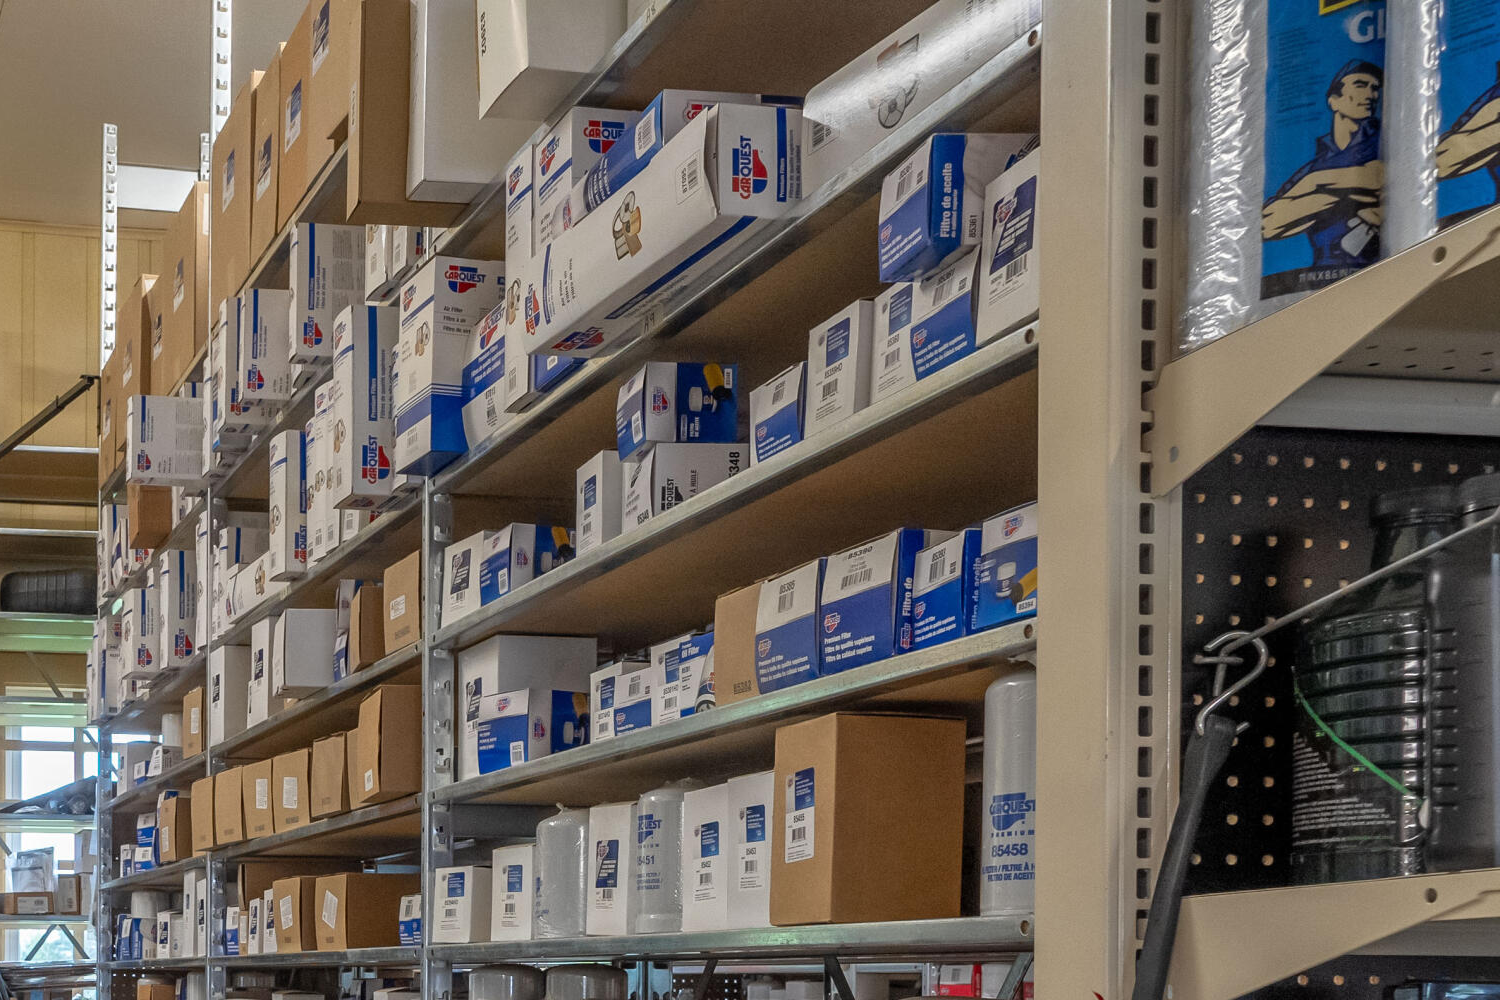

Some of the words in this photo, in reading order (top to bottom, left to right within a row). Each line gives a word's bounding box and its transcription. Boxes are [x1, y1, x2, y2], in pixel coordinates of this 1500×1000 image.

[740, 135, 752, 200] CARQUEST
[943, 162, 953, 197] aceite
[942, 198, 951, 210] de
[940, 211, 951, 239] Filtro
[444, 269, 487, 284] CARQUEST
[367, 435, 378, 486] CARQUEST
[902, 577, 912, 590] de
[902, 591, 912, 617] Filtro
[824, 633, 840, 644] Premium
[840, 631, 852, 640] Filter
[687, 646, 699, 657] Filter
[991, 843, 1028, 857] 85458
[1002, 862, 1022, 873] FILTRE
[1004, 872, 1012, 881] DE
